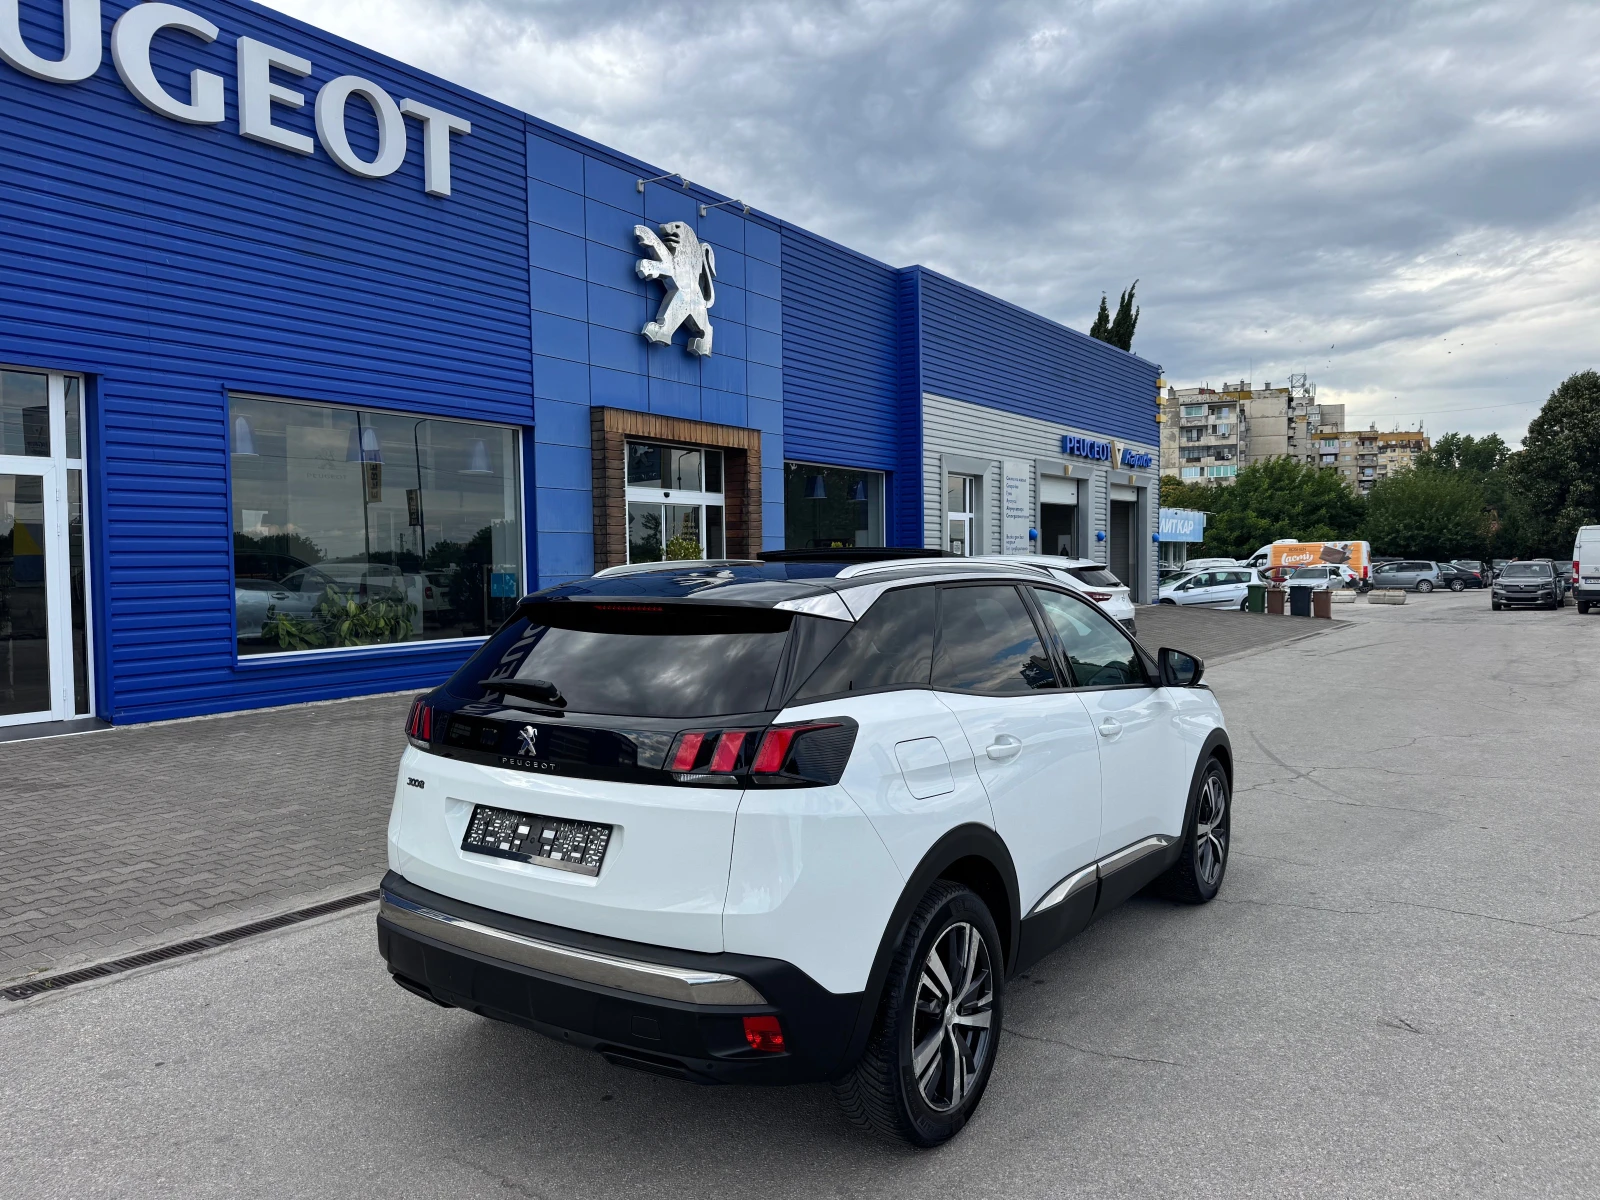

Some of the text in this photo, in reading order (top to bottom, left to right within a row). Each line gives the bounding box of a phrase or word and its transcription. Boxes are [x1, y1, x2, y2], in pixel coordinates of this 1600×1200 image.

[0, 0, 471, 197] UGEOT
[1064, 435, 1112, 461] PEUGEOT
[502, 757, 556, 770] PEUGEOT
[406, 777, 425, 789] 3008
